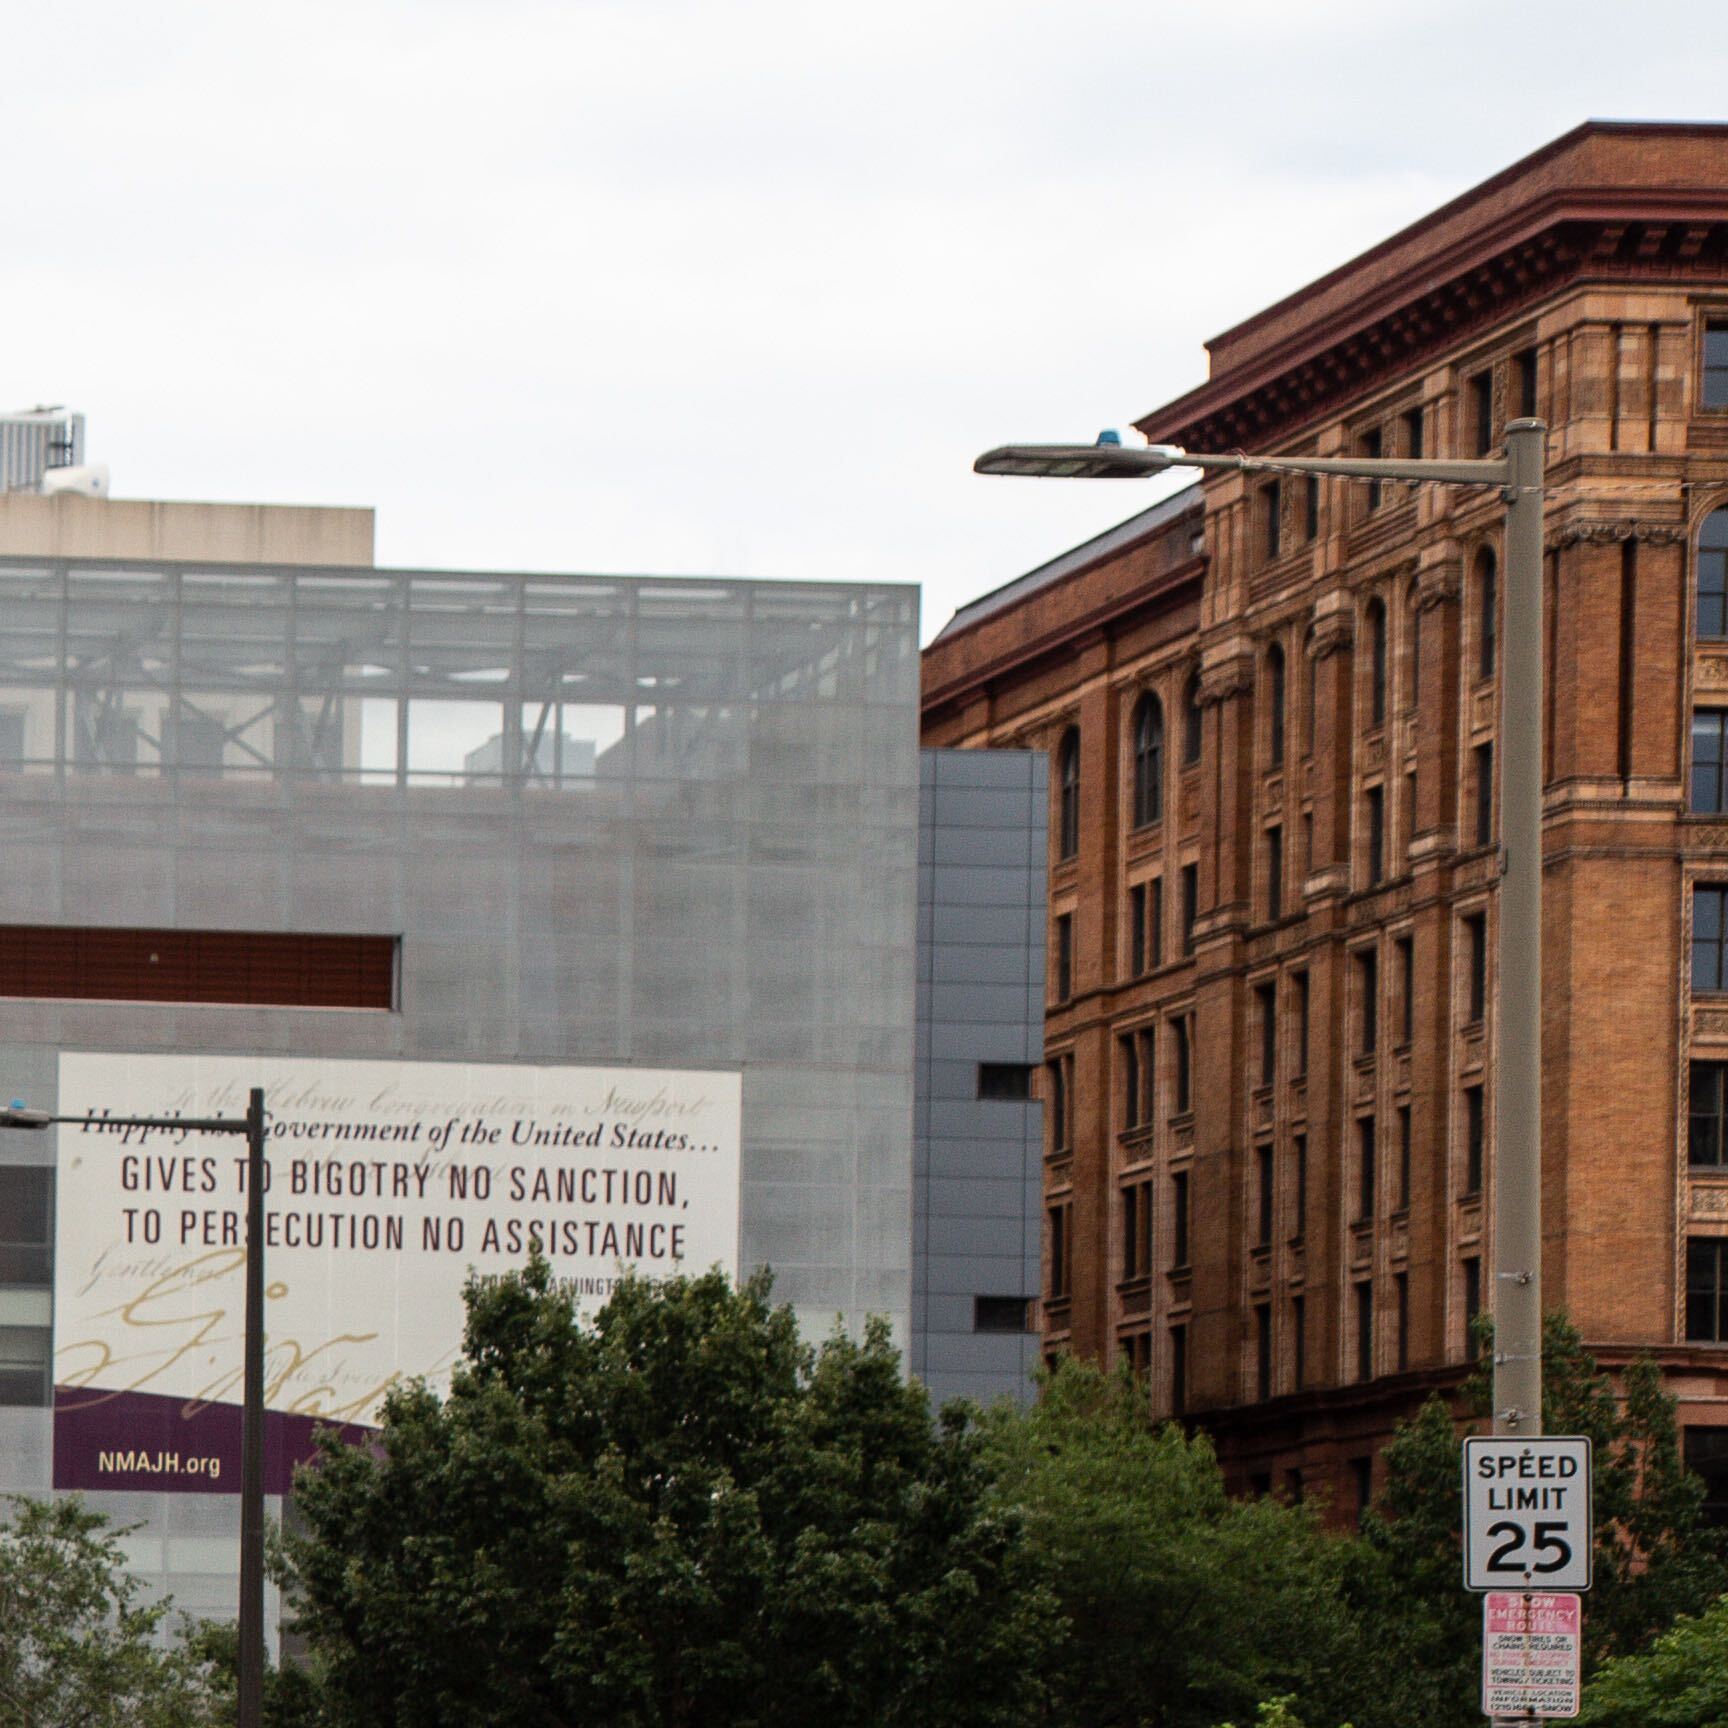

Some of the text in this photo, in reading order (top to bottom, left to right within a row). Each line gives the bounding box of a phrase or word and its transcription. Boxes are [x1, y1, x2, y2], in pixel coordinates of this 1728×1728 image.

[428, 1118, 459, 1151] of
[461, 1118, 501, 1143] the
[511, 1120, 601, 1147] United
[121, 1156, 217, 1193] GIVES
[292, 1159, 429, 1198] BIGOTRY
[450, 1165, 490, 1200] NO
[510, 1167, 689, 1209] SANCTION,
[122, 1208, 686, 1259] TO PERECUTION NO ASSISTANCE
[97, 1451, 221, 1477] NMAJH.org
[1478, 1455, 1578, 1479] SPEED
[1488, 1487, 1568, 1511] LIMIT
[1486, 1521, 1572, 1573] 25
[1488, 1609, 1576, 1620] EMERGENCY
